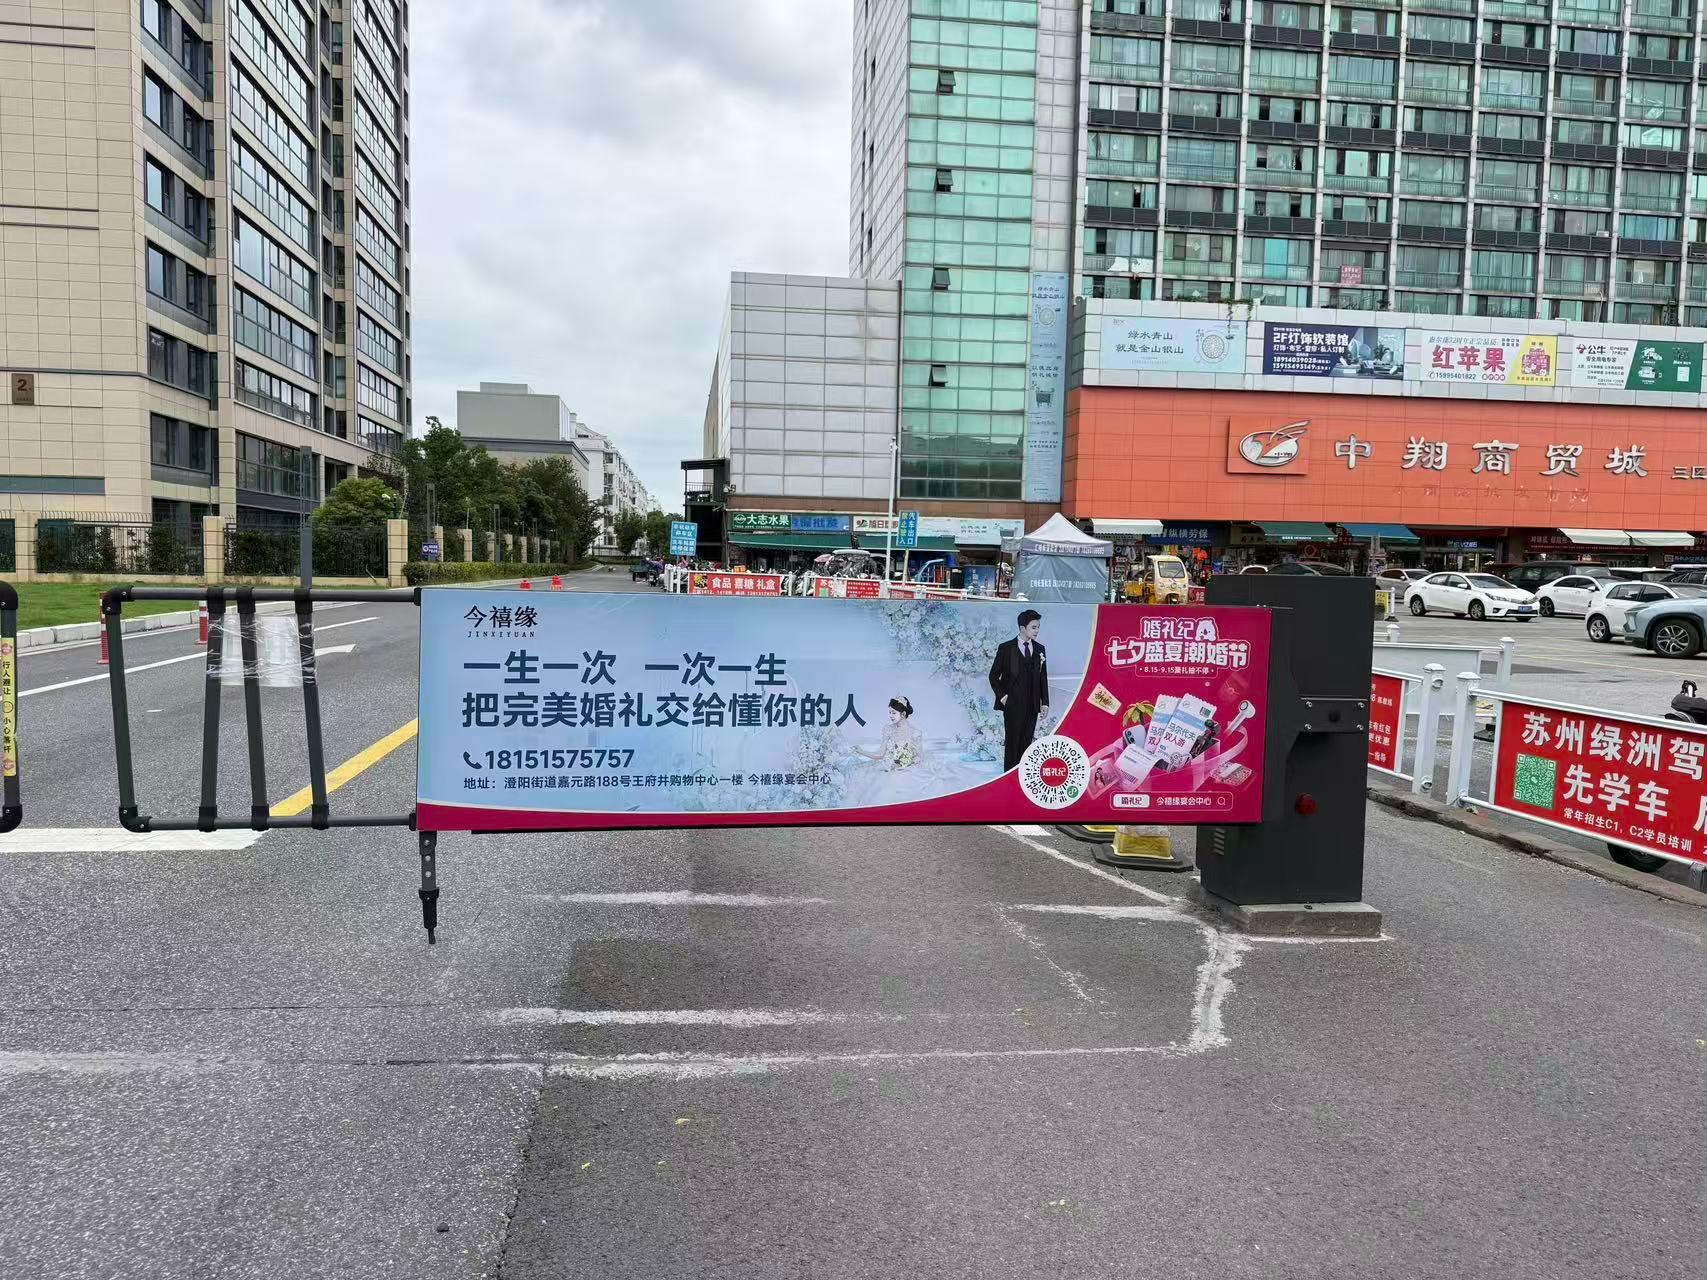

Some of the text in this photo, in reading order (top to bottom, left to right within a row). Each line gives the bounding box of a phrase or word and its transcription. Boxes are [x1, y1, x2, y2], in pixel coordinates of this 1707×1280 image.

[1128, 330, 1173, 340] 绿水青山
[1273, 332, 1349, 346] 2F灯饰软装馆
[1116, 344, 1184, 354] 就是金山银山
[1432, 345, 1506, 372] 红苹果
[1587, 345, 1607, 354] 公牛
[1335, 434, 1649, 477] 中翔商贸城
[747, 514, 790, 526] 大志水果
[908, 512, 916, 545] 汽车出口
[712, 577, 732, 589] 食品
[756, 579, 776, 590] 礼盒
[463, 605, 539, 630] 今禧缘
[1143, 620, 1195, 640] 婚礼纪
[1107, 639, 1248, 668] 七夕盛夏潮婚节
[463, 649, 788, 687] 一生一次 一次一生
[462, 692, 867, 728] 把完美婚礼交给懂你的人
[1167, 722, 1197, 741] 马尔代夫
[1521, 711, 1705, 781] 苏州绿洲驾
[485, 749, 635, 770] 18151575757
[748, 774, 832, 787] 今禧缘宴会中心
[1042, 767, 1067, 777] 婚礼纪
[1121, 796, 1212, 806] 婚礼纪 今禧缘宴会中心
[1562, 764, 1670, 822] 先学车
